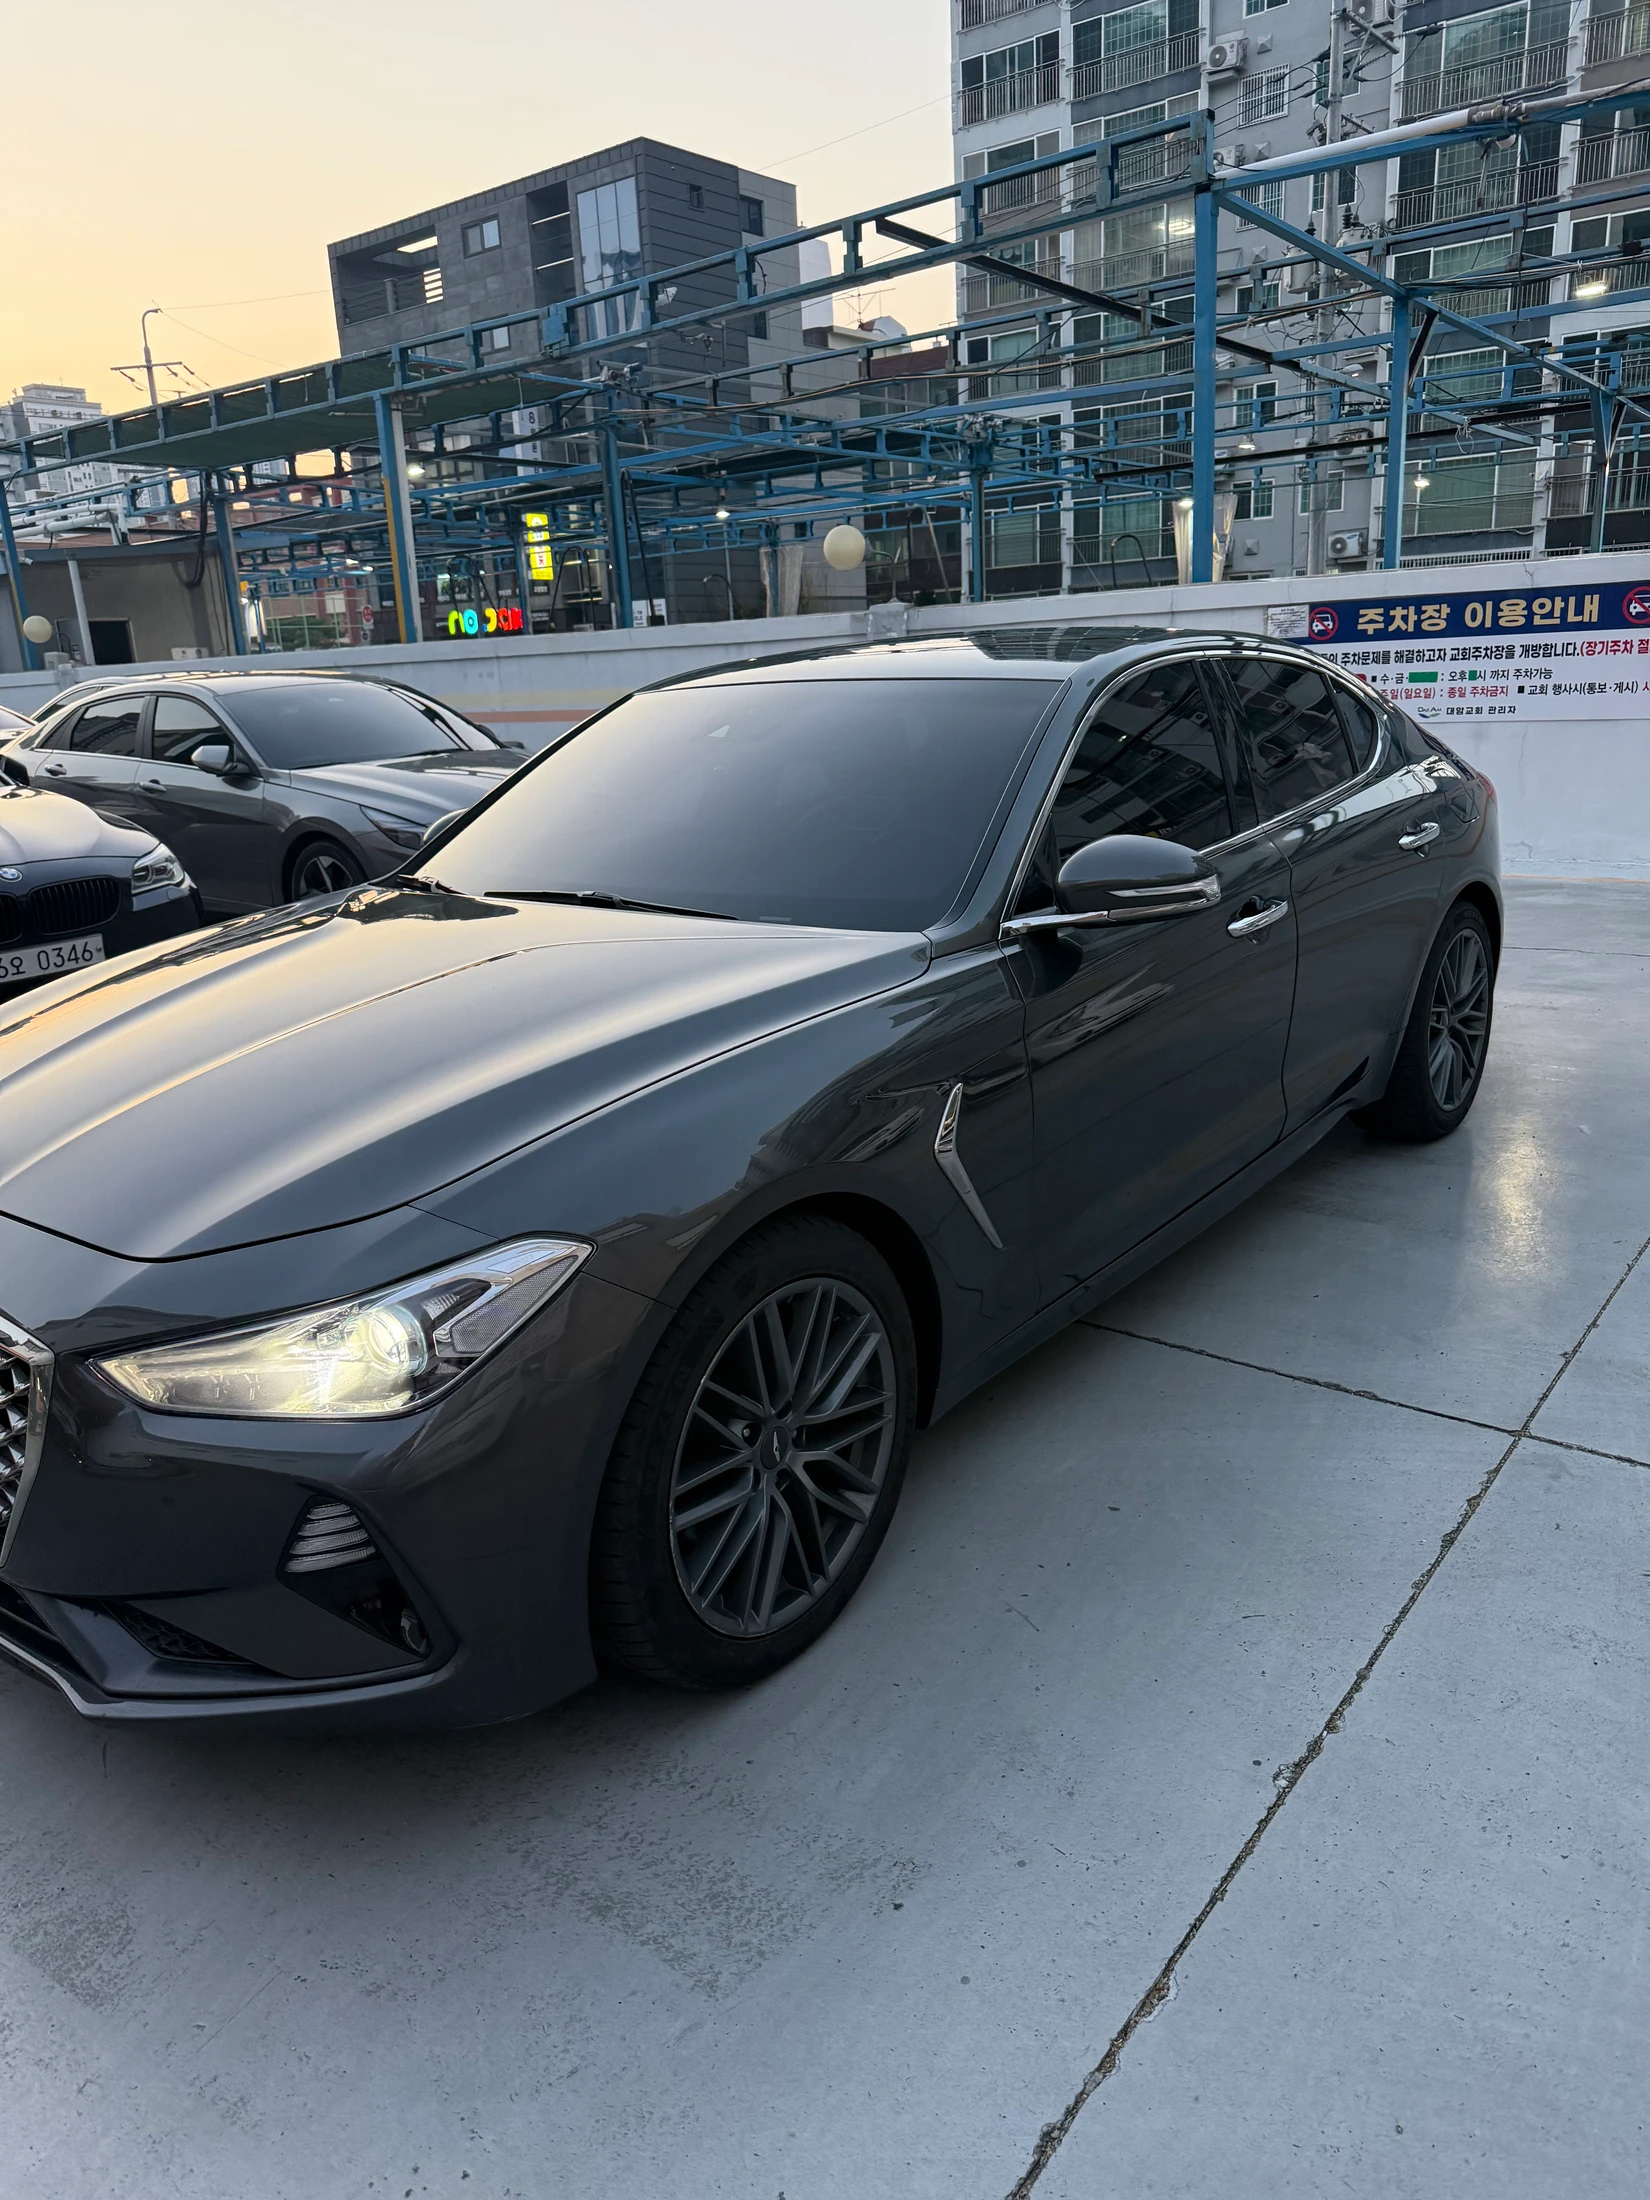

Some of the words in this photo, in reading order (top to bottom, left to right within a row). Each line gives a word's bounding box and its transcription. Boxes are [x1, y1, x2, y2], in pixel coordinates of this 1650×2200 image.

[1357, 604, 1450, 635] 주차장
[1464, 594, 1600, 628] 이용안내
[1341, 650, 1392, 666] 주차문제를
[1393, 647, 1447, 663] 해결하고자
[1450, 644, 1516, 661] 교회주차장을
[1489, 668, 1510, 680] 까지
[1512, 668, 1553, 680] 주차가능
[1448, 686, 1467, 698] 종일
[1470, 685, 1509, 697] 주차금지
[1527, 684, 1549, 696] 교회
[1488, 705, 1517, 715] 관리자
[37, 941, 93, 970] 0346
